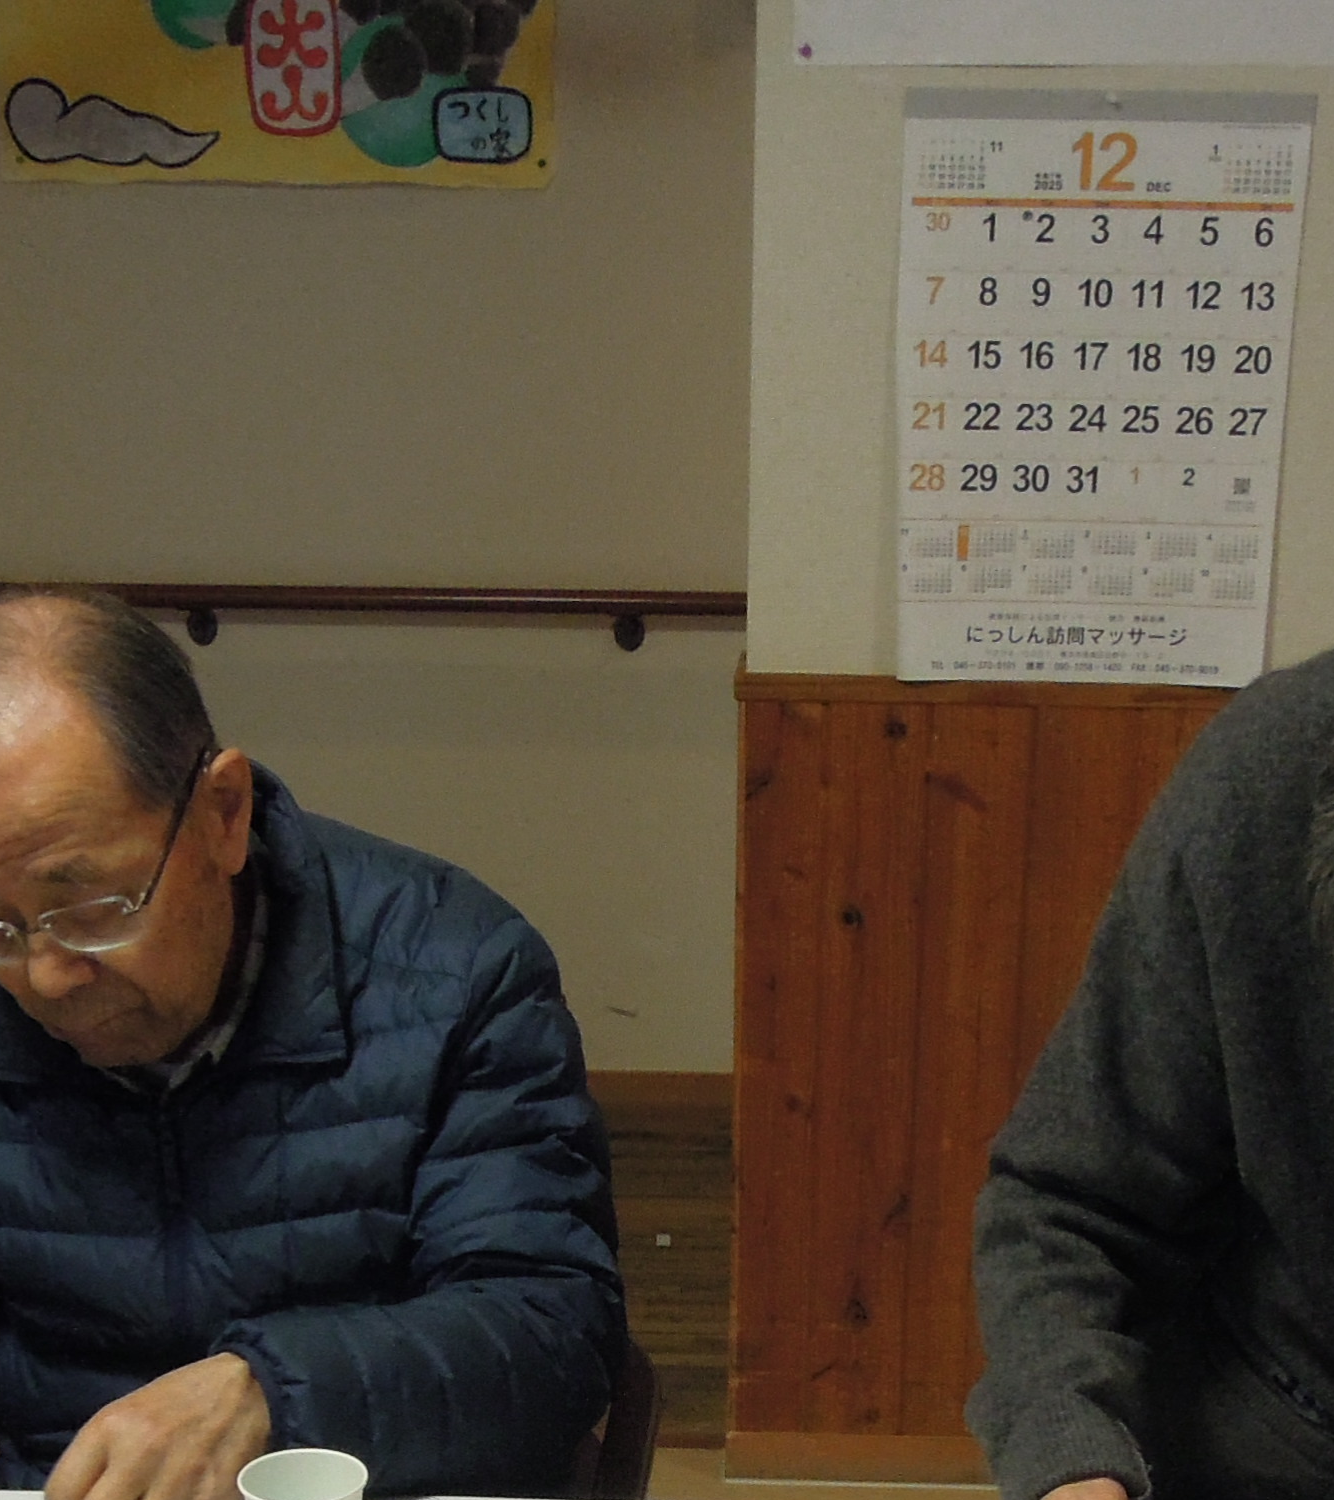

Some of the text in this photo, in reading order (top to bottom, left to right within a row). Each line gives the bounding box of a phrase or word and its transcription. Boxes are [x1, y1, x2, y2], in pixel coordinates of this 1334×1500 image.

[447, 96, 510, 123] つくし
[989, 140, 1004, 153] 11
[1071, 131, 1138, 192] 12
[1033, 180, 1064, 191] 2025
[1146, 181, 1172, 193] DEC
[926, 212, 1274, 248] 30 1 2 3 4 5 6
[926, 275, 1275, 312] 7 8 9 10 11 12 13
[913, 339, 1272, 375] 14 15 16 17 18 19 20
[912, 401, 1268, 437] 21 22 23 24 25 26 27
[909, 463, 1196, 494] 28 29 30 31 1 2
[966, 626, 1187, 647] にっしん訪問マッサージ
